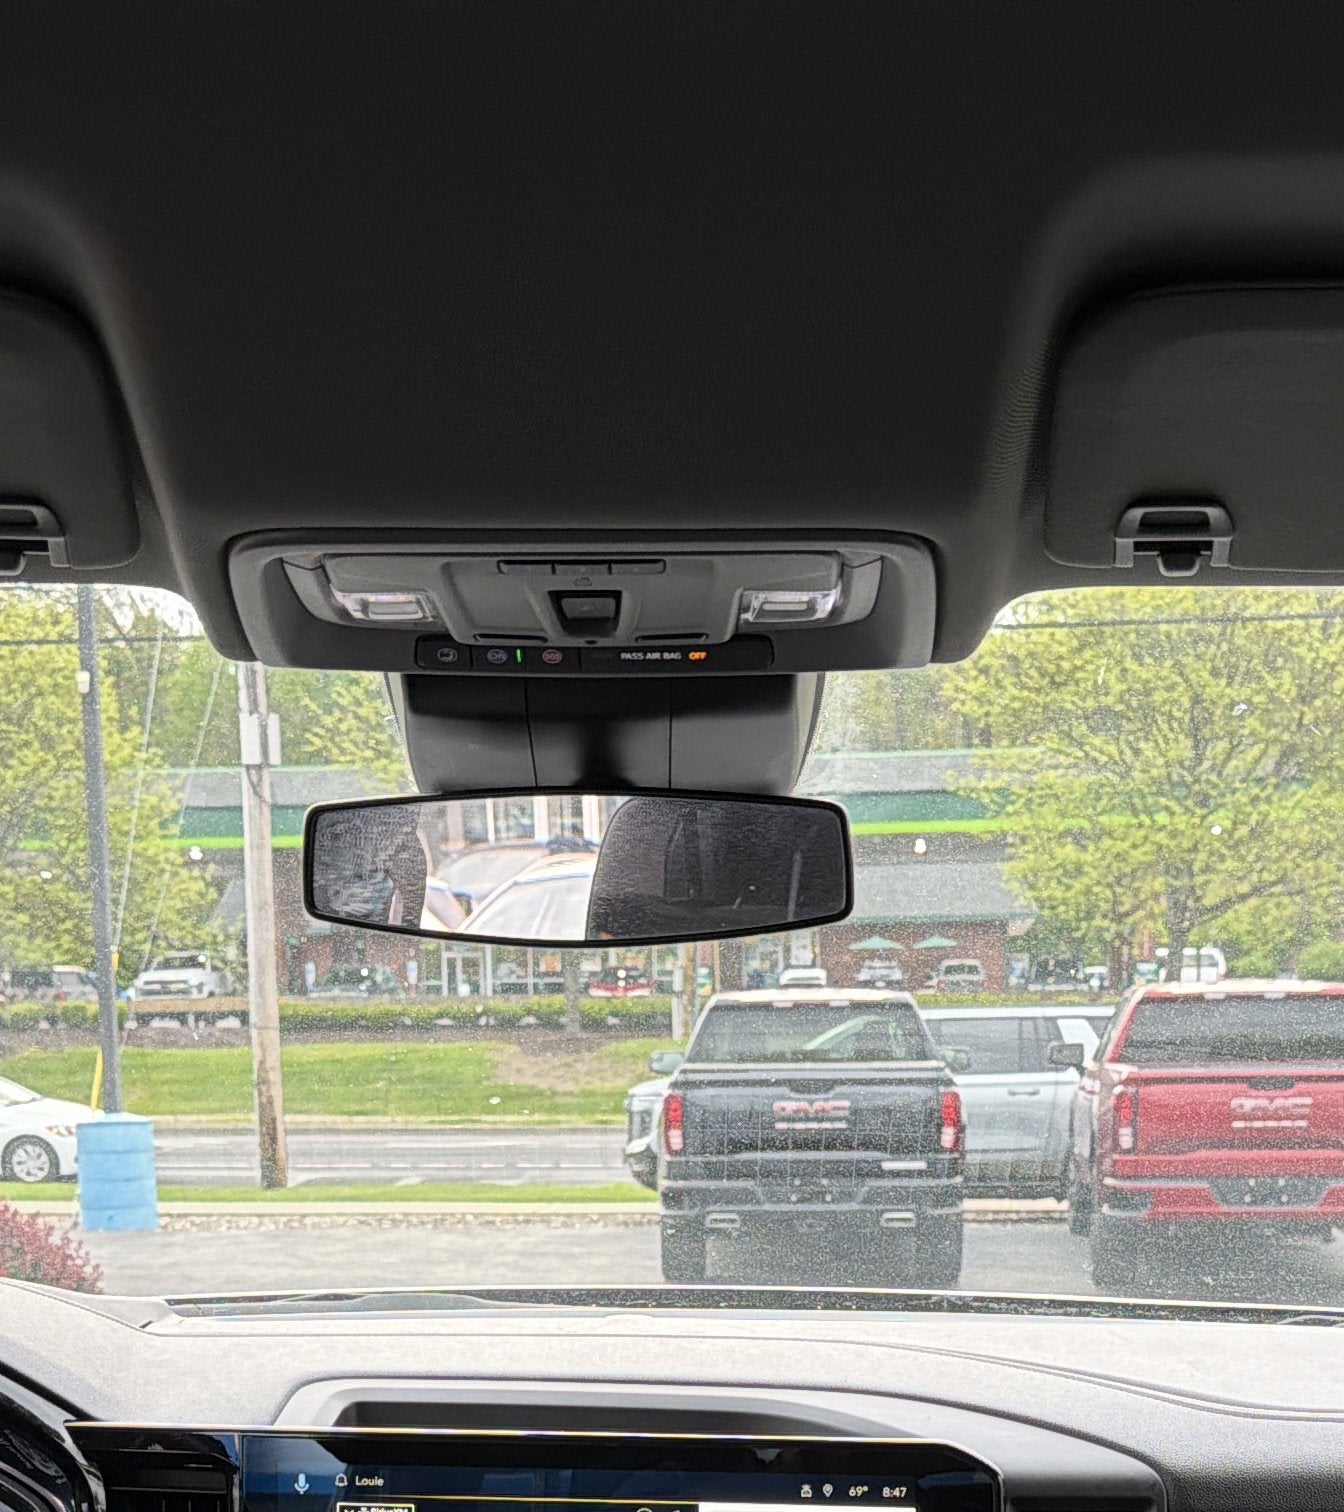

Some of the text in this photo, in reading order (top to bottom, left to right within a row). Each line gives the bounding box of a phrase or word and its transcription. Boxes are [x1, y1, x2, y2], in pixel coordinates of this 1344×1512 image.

[620, 651, 707, 661] PASS AIR BAG OFF
[355, 1475, 385, 1487] Louie
[849, 1485, 869, 1497] 69°
[882, 1486, 907, 1499] 8:47
